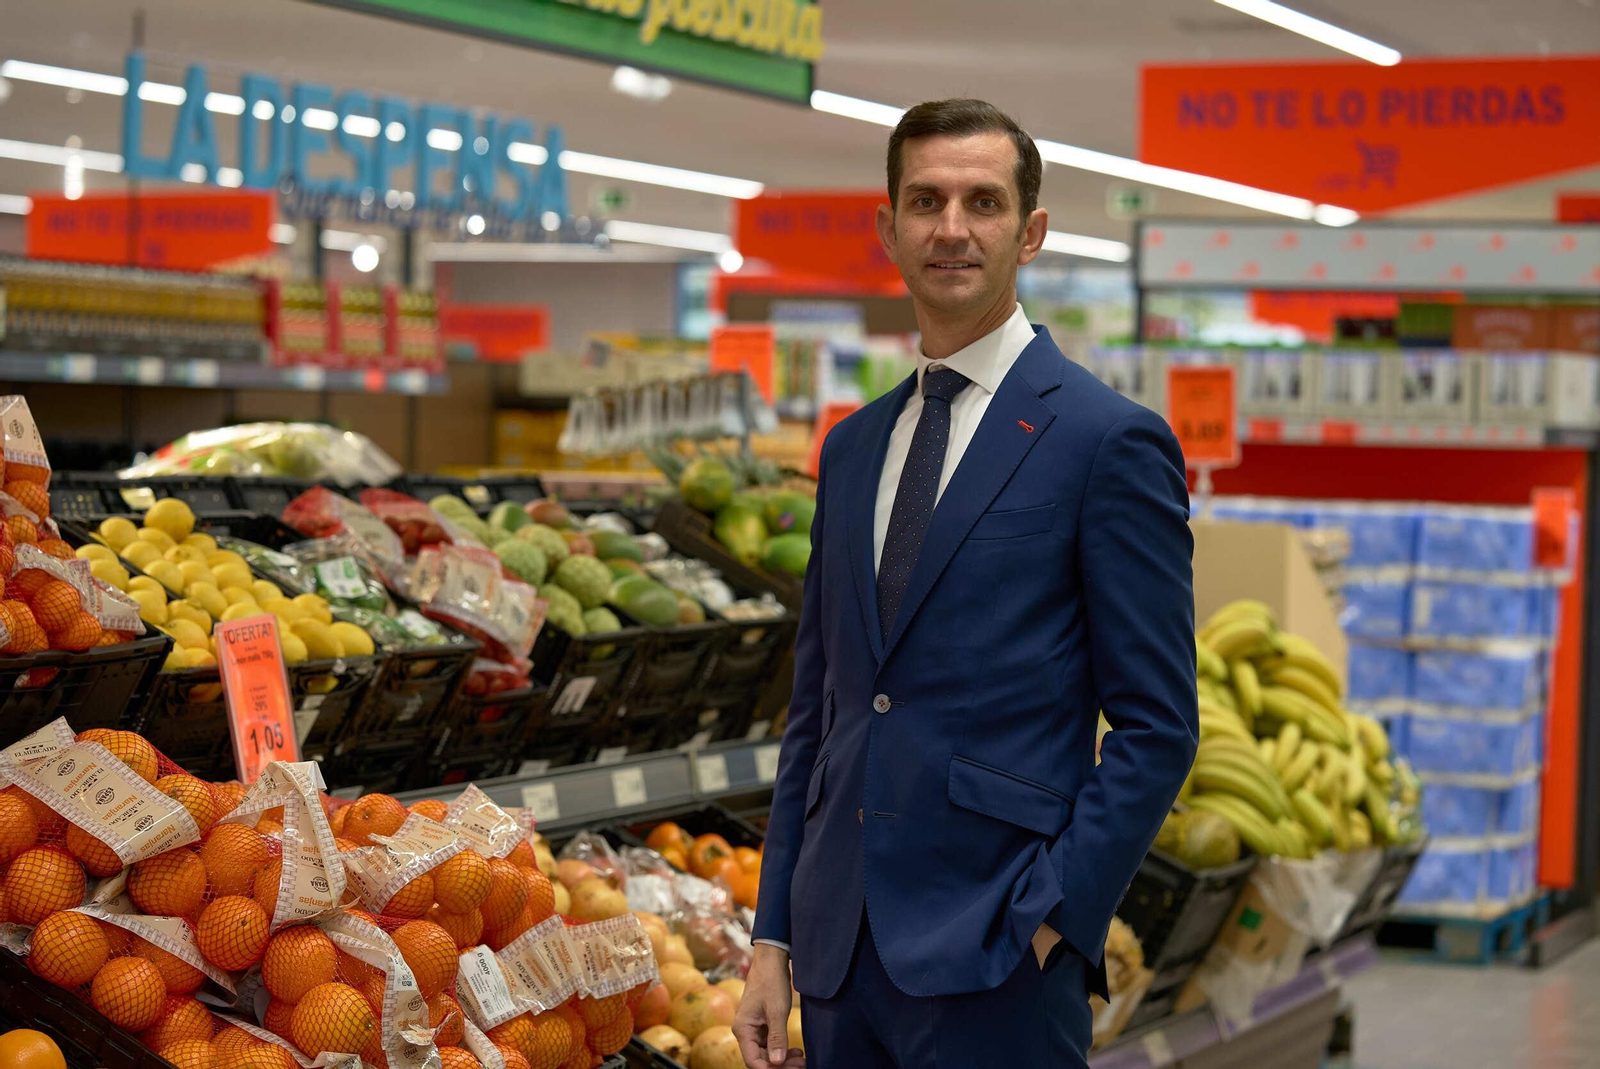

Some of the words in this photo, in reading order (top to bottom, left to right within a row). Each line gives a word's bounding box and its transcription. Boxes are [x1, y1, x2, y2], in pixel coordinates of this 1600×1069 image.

[1178, 90, 1237, 129] NO
[1248, 89, 1300, 128] TE
[1312, 88, 1367, 128] LO
[1379, 84, 1566, 127] PIERDAS
[122, 52, 218, 186] LA
[239, 73, 571, 225] DESPENSA
[250, 722, 284, 755] 1.05
[63, 762, 98, 793] Naranjas
[102, 794, 138, 821] Naranjas
[140, 824, 176, 853] Naranjas
[480, 957, 491, 976] 4000
